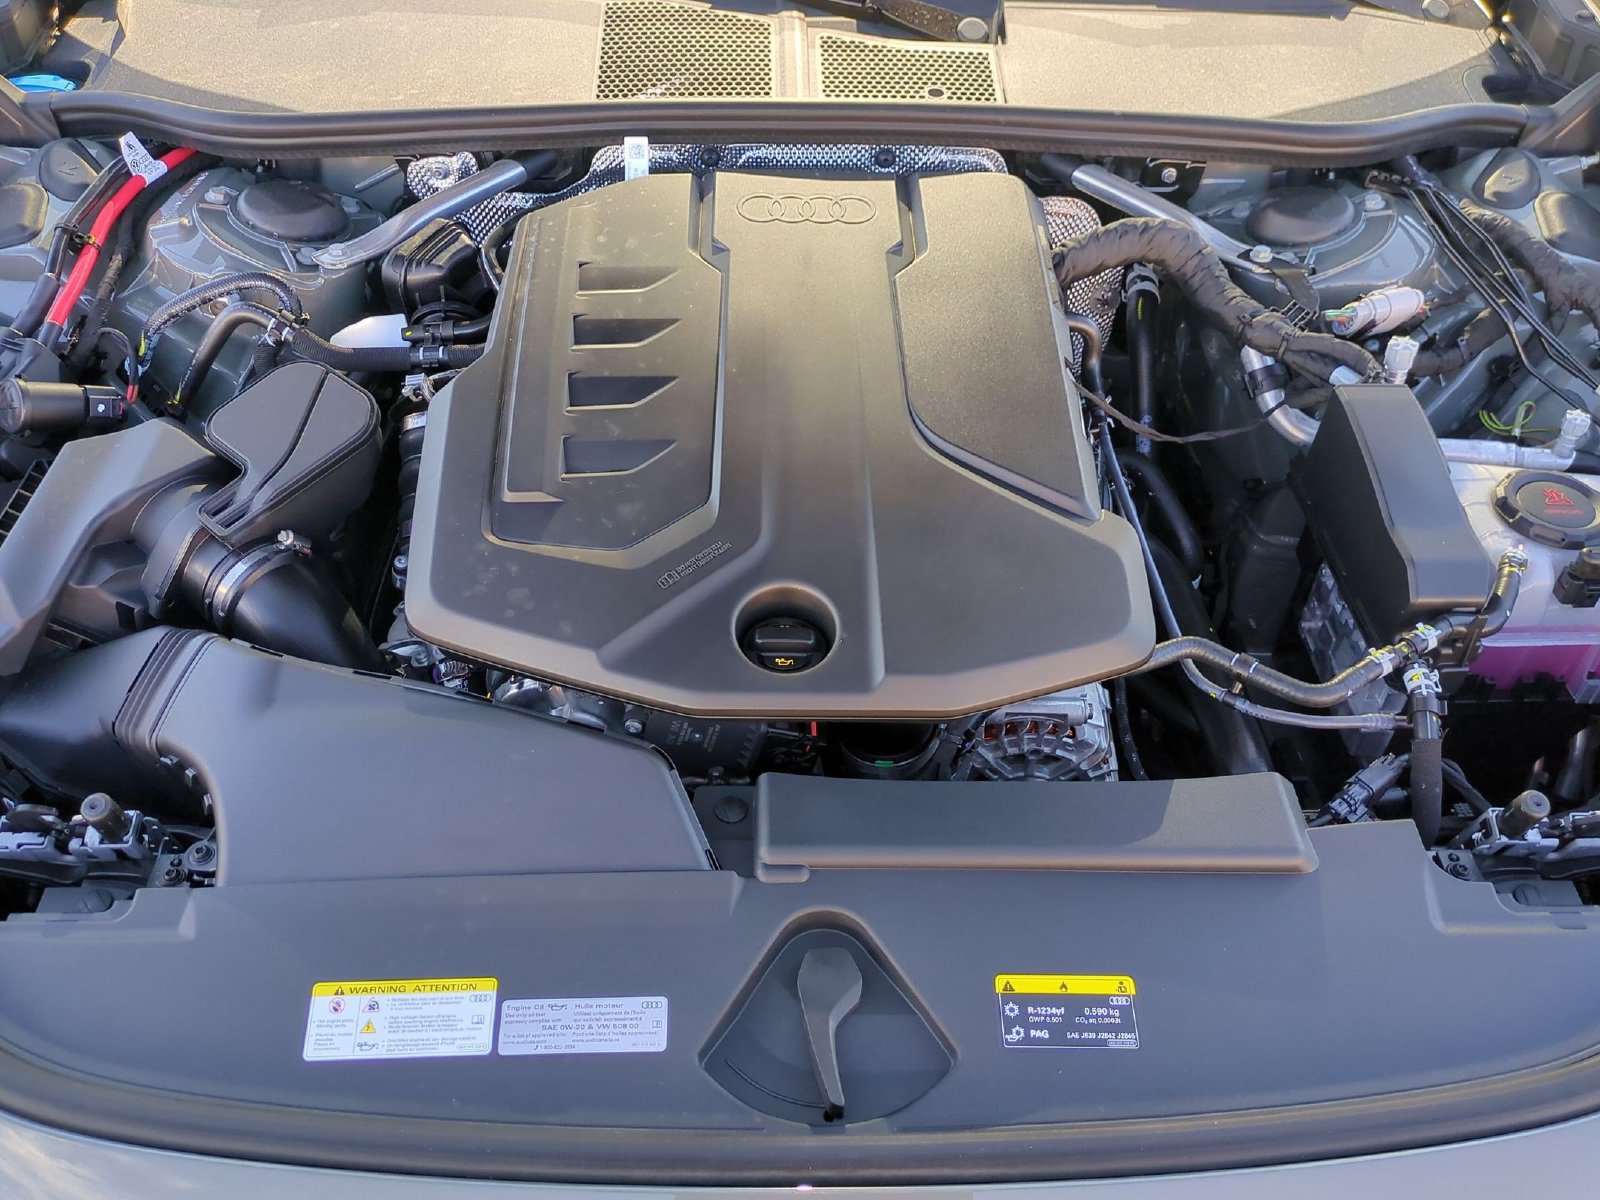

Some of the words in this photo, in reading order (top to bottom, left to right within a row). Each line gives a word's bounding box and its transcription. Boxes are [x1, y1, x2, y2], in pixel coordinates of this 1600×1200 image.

[350, 985, 406, 994] WARNING
[413, 983, 477, 992] ATTENTION
[1028, 1007, 1065, 1015] R-1234yf
[1109, 1008, 1120, 1016] kg
[1030, 1030, 1049, 1038] PAG
